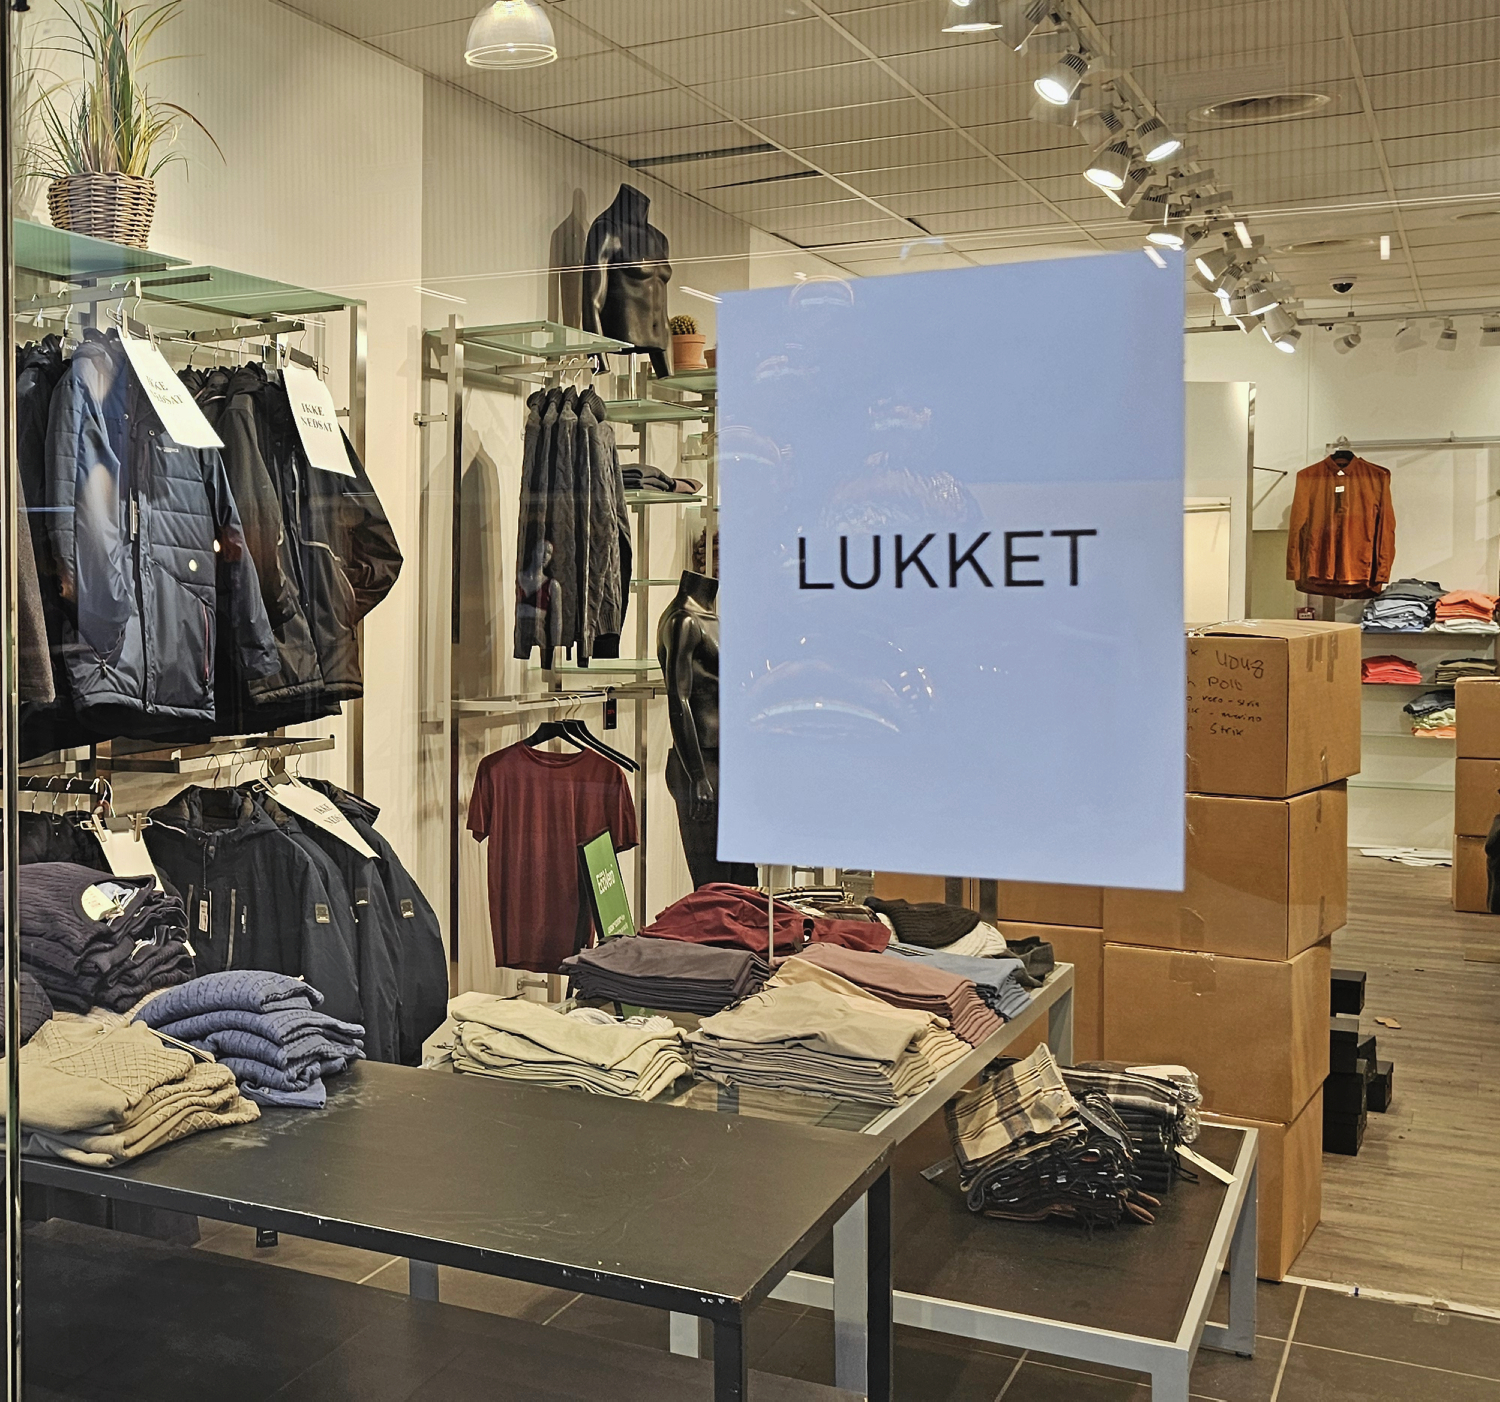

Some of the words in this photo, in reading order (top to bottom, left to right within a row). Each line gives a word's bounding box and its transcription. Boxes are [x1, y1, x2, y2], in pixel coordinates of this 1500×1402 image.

[301, 402, 325, 417] IKKE
[300, 415, 333, 433] NEDSAT
[798, 528, 1098, 590] LUKKET
